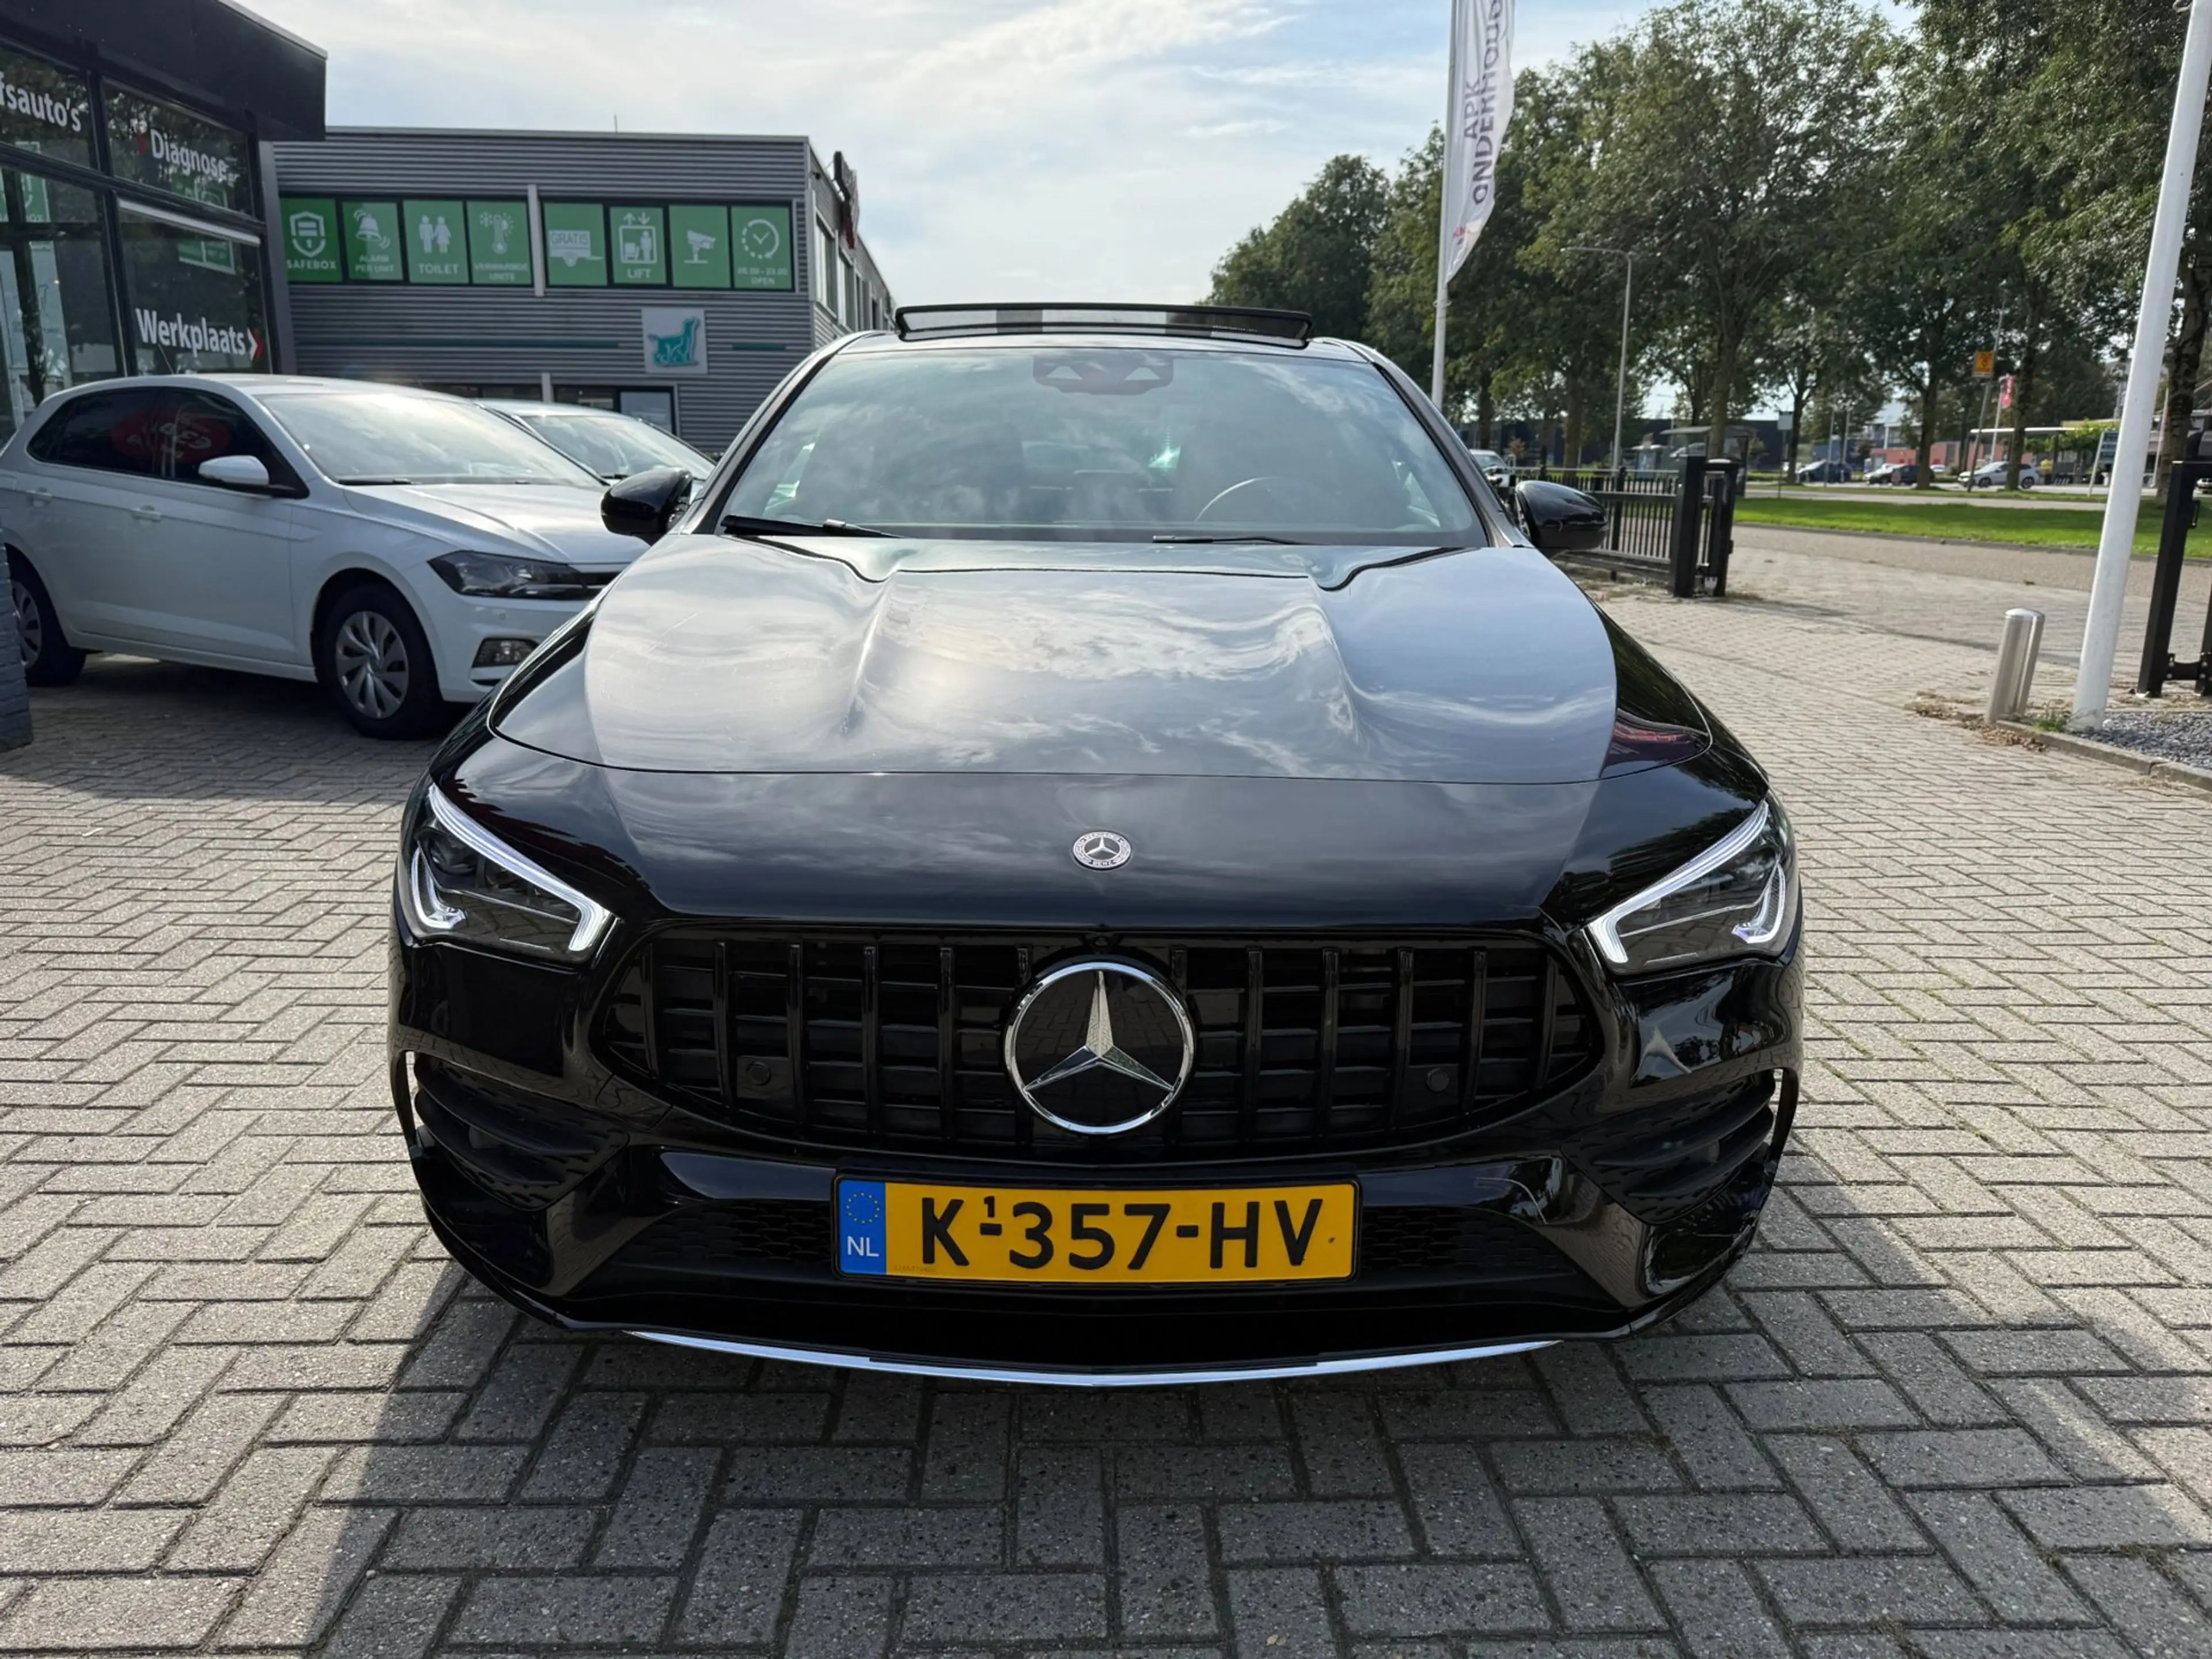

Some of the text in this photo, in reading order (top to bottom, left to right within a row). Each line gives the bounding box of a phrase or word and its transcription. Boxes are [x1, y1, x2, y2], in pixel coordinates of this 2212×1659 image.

[1464, 81, 1481, 139] APK
[150, 128, 229, 179] Diagnose
[551, 232, 588, 245] GRATIS
[286, 259, 336, 270] SAFEBOX
[418, 263, 459, 274] TOILET
[627, 268, 651, 279] LIFT
[135, 308, 245, 357] Werkplaats
[847, 1236, 879, 1257] NL
